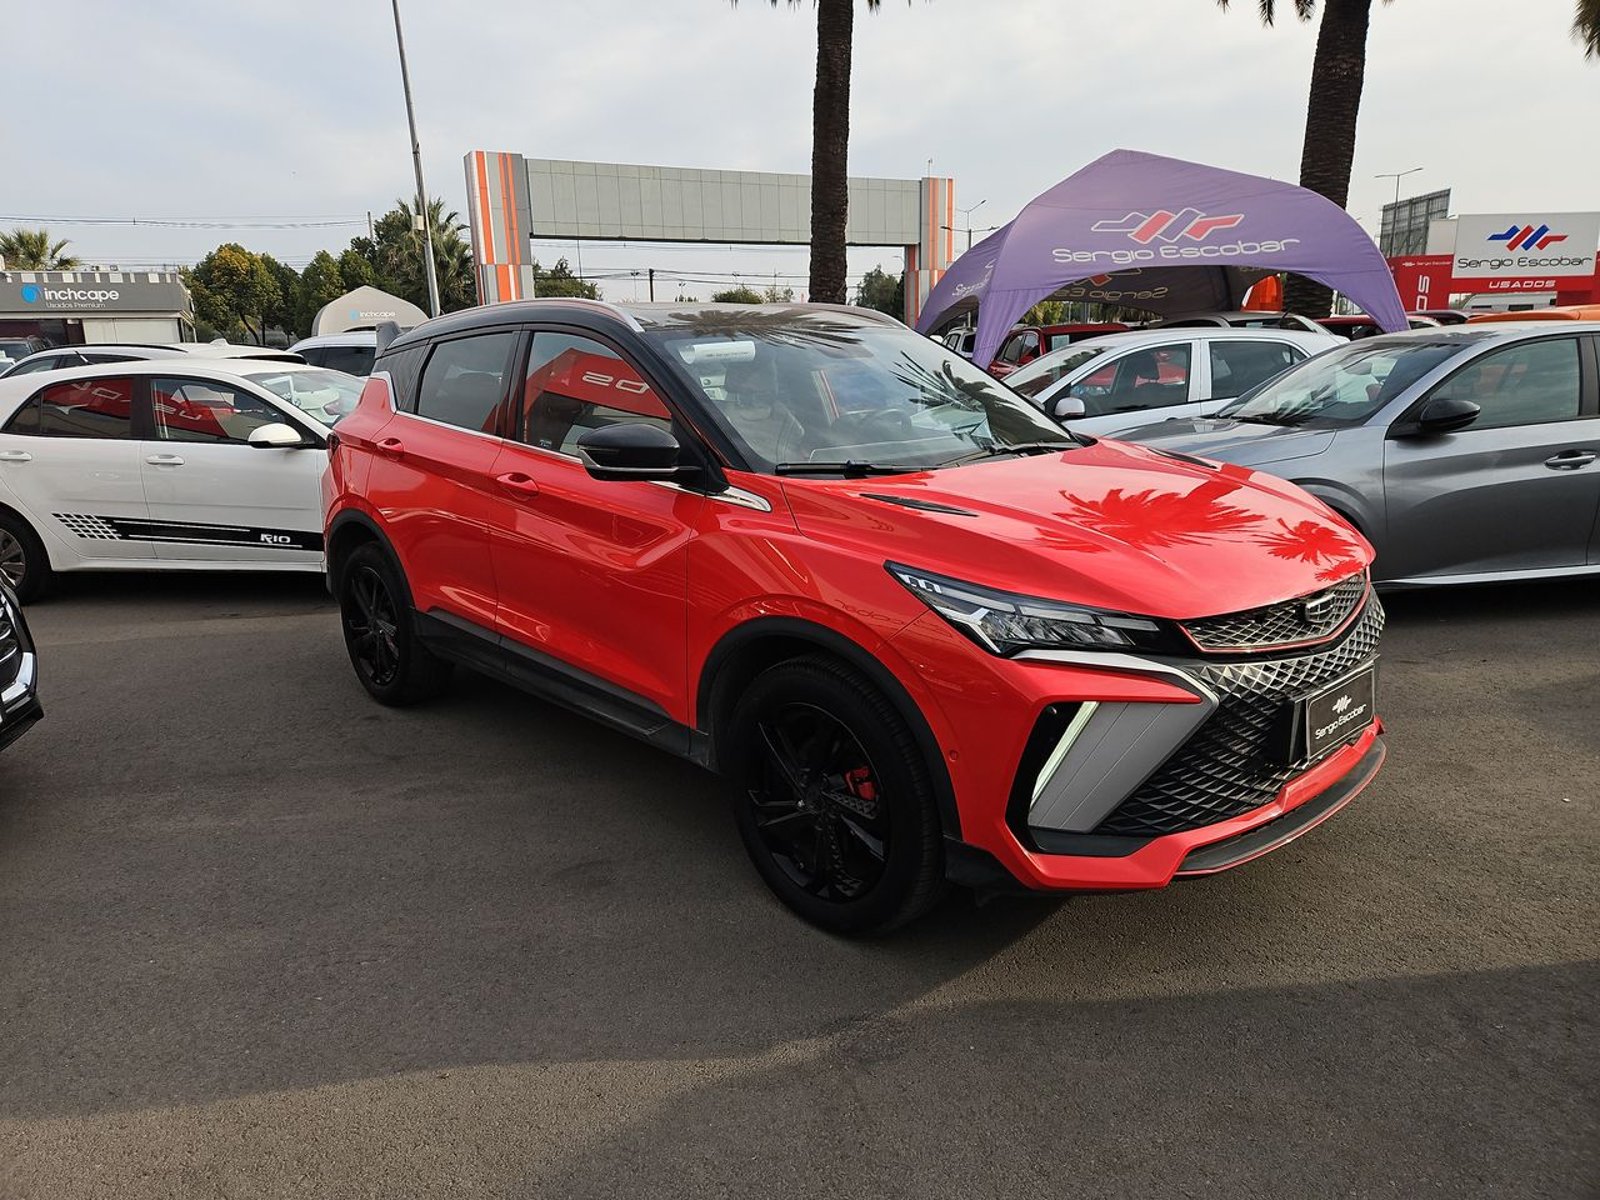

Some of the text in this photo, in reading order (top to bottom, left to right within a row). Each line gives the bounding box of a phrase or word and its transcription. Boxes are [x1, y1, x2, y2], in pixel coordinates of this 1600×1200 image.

[1052, 239, 1300, 264] Sergio Escobar
[1457, 256, 1592, 270] Sergio Escobar
[1488, 279, 1556, 289] USADOS
[44, 287, 120, 302] inchcape
[260, 533, 291, 544] RIO
[1338, 704, 1367, 726] Escobar
